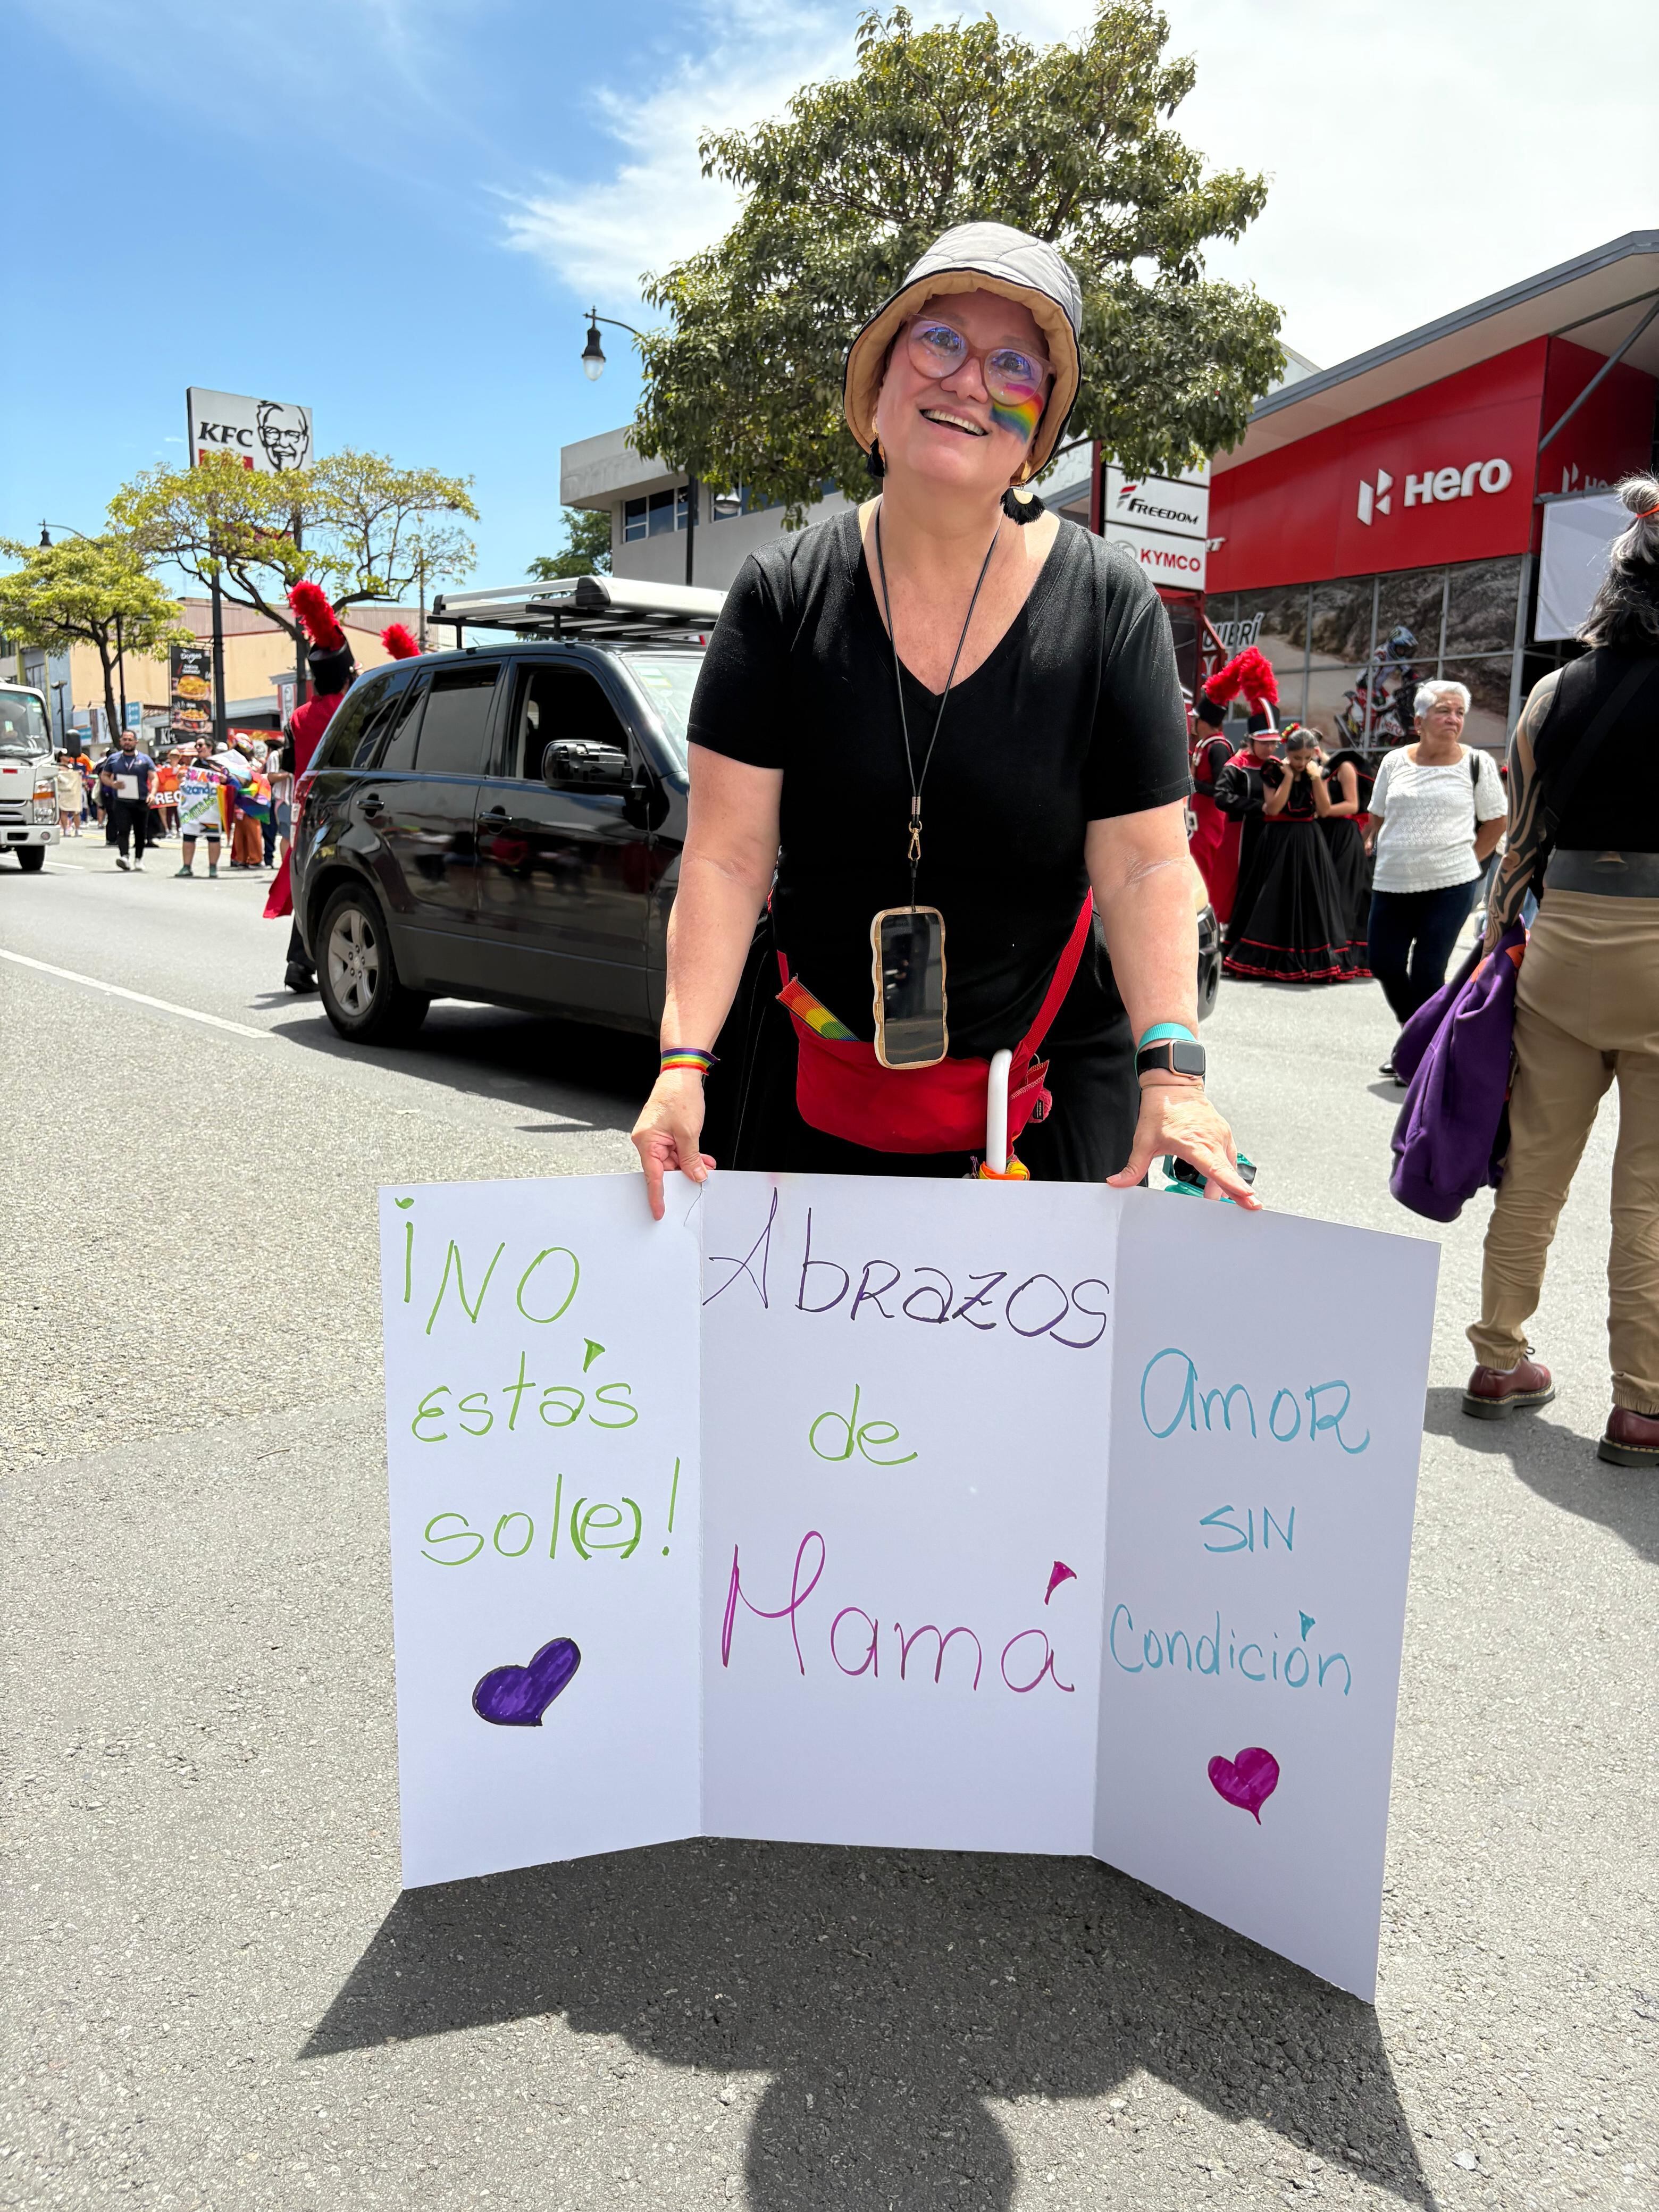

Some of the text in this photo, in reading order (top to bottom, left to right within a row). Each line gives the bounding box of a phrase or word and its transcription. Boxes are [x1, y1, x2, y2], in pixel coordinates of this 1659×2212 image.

[198, 421, 253, 447] KFC
[1403, 458, 1513, 507] Hero
[1127, 498, 1200, 525] FREEDOM
[1140, 548, 1201, 573] KYMCO
[809, 1383, 918, 1466] de
[1199, 1504, 1295, 1553] SIN
[721, 1530, 1078, 1693] Mamá
[1110, 1603, 1352, 1696] Condición
